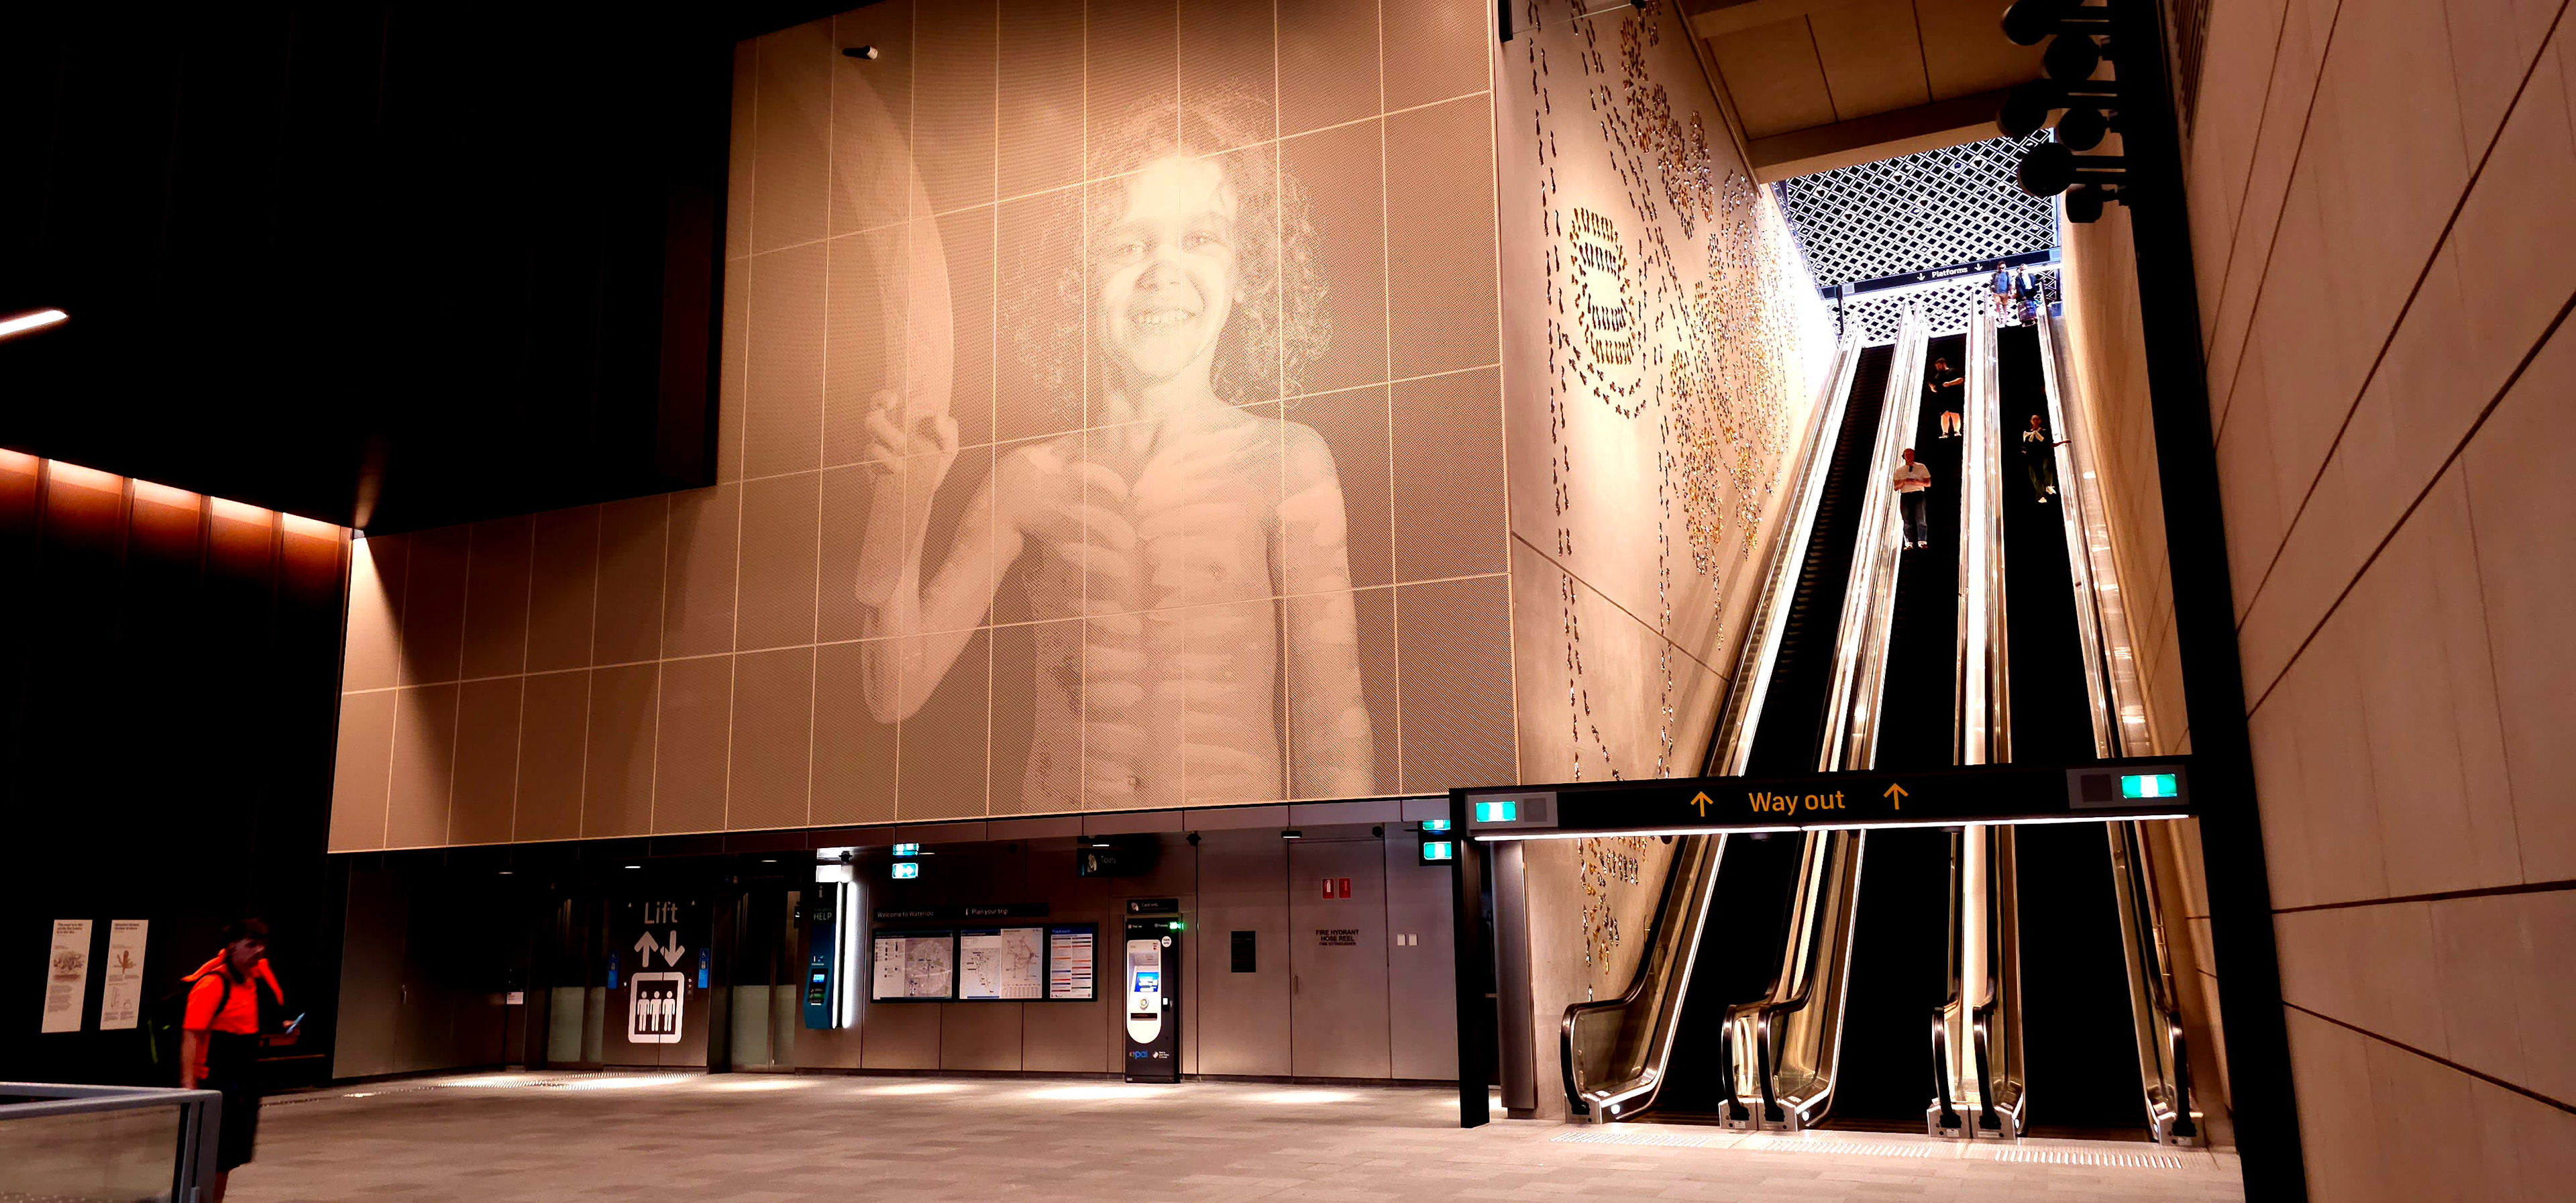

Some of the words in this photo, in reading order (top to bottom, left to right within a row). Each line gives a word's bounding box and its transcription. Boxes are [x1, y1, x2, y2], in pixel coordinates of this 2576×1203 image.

[1931, 267, 1968, 278] Platforms
[1748, 792, 1799, 816] Way
[1805, 790, 1845, 810] out
[644, 901, 678, 924] Lift
[813, 912, 833, 921] HELP
